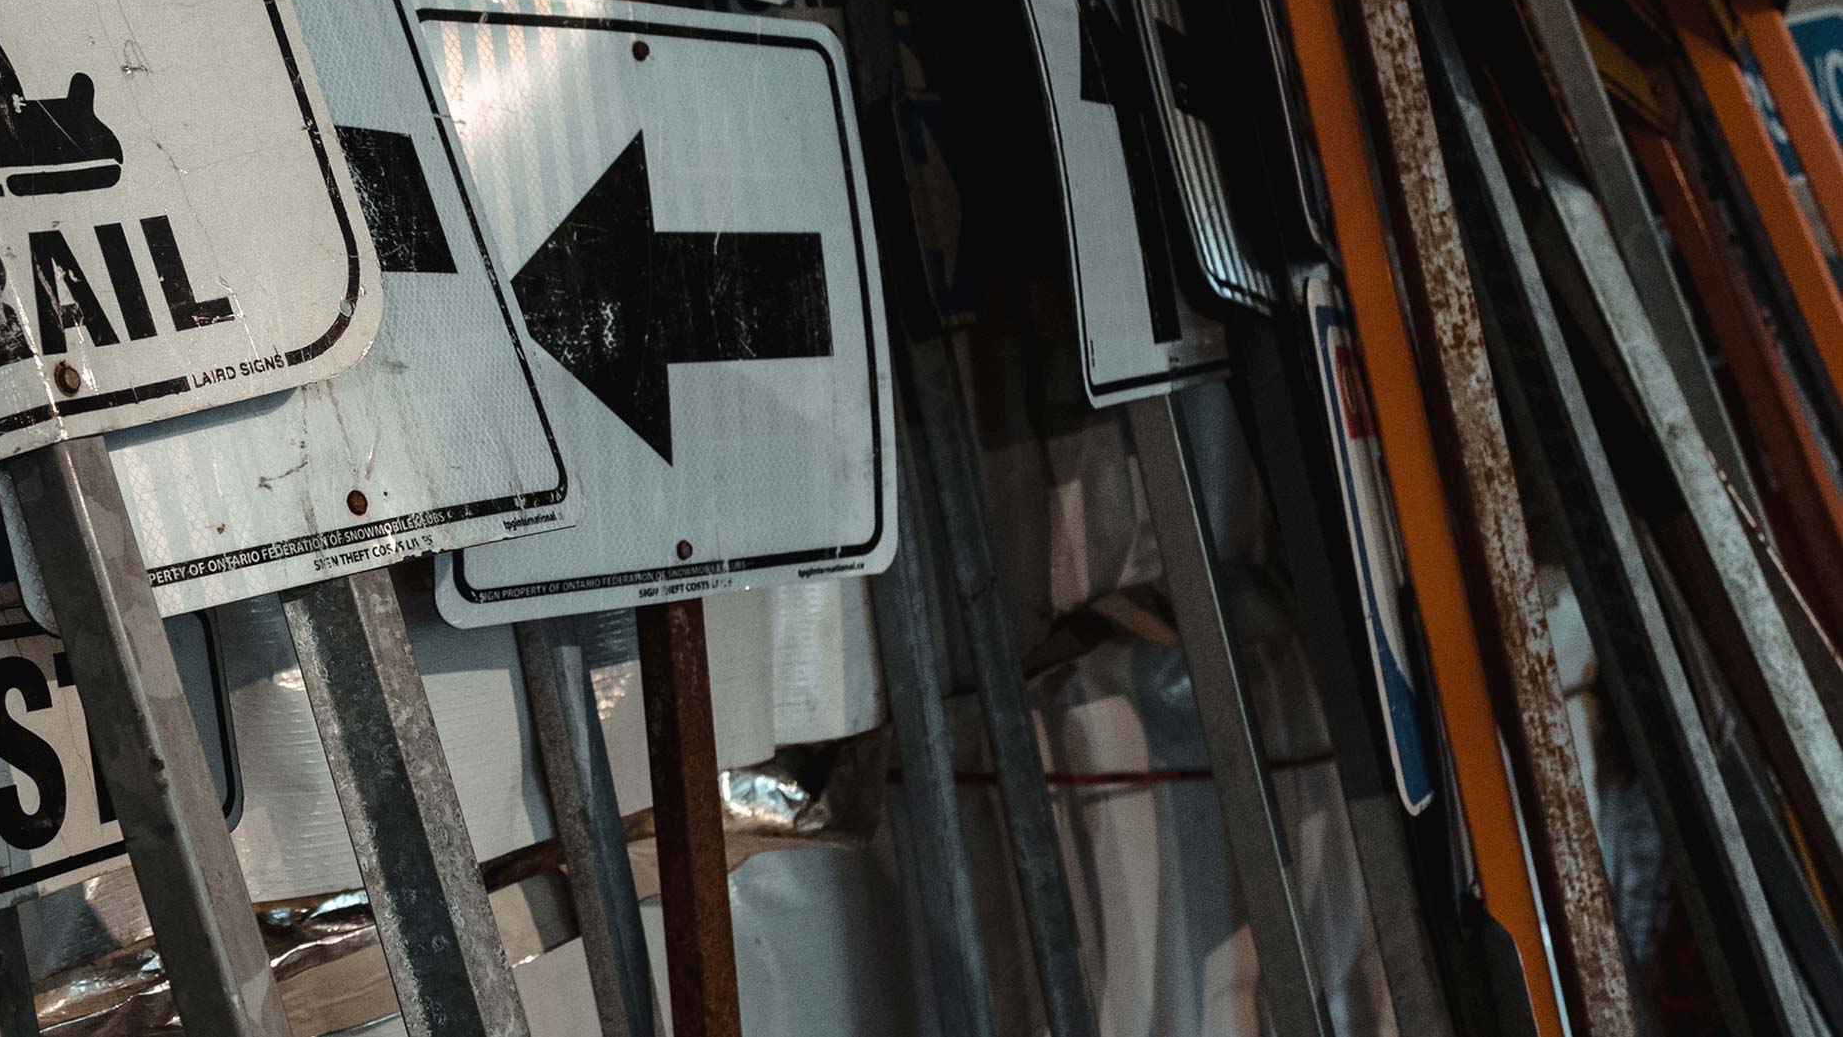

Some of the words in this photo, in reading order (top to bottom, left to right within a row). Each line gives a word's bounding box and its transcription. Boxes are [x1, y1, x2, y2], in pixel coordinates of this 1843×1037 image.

[191, 365, 237, 389] LAIRD
[239, 354, 285, 377] SIGNS
[188, 561, 208, 579] OF
[208, 550, 260, 574] ONTARIO
[261, 534, 331, 563] FEDERATION
[331, 531, 345, 547] OF
[344, 517, 415, 546] SNOWMOBILE
[340, 546, 370, 565] THEFT
[372, 539, 407, 559] COSS
[501, 583, 547, 601] PROPERTY
[562, 576, 602, 593] ONTARIO
